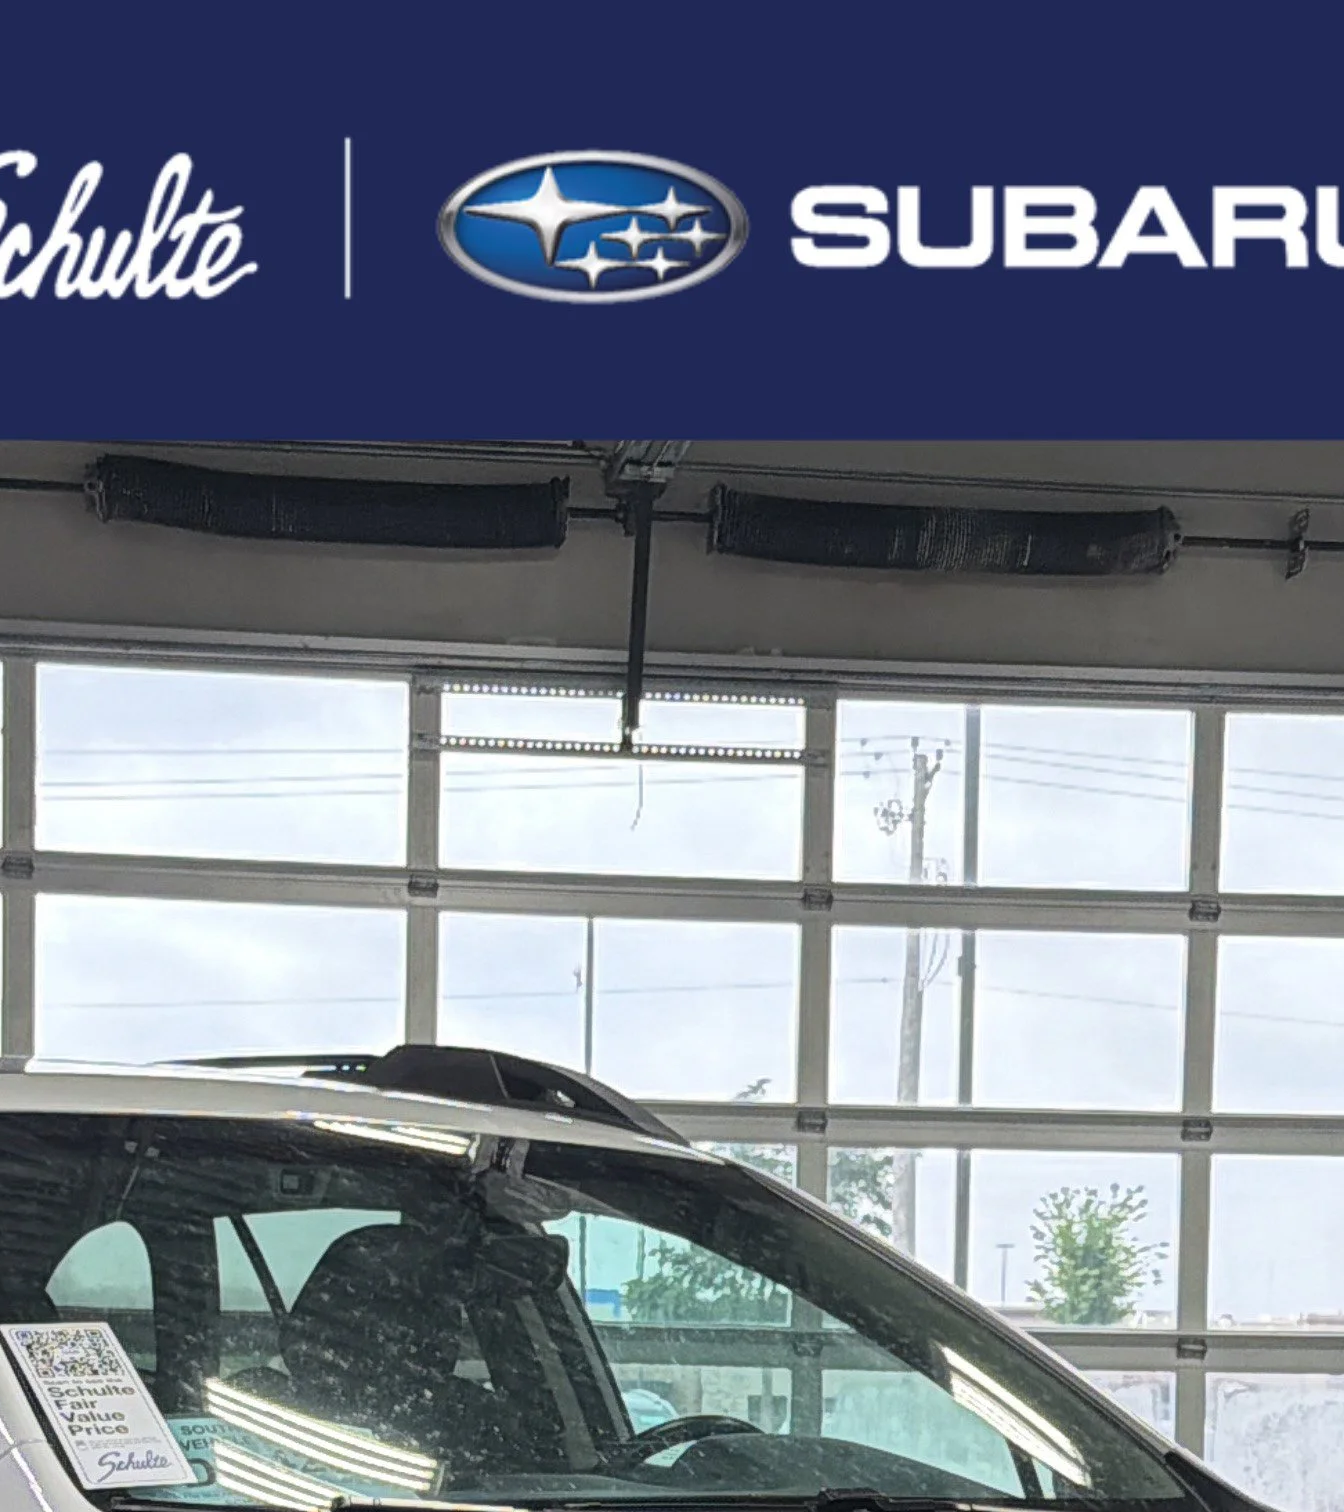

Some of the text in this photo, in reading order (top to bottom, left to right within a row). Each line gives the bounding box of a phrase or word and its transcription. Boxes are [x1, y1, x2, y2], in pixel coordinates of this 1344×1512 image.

[47, 1384, 135, 1398] Schulte
[54, 1398, 97, 1411] Fair
[59, 1410, 126, 1423] Value
[67, 1423, 130, 1437] Price
[96, 1449, 173, 1483] Schulte
